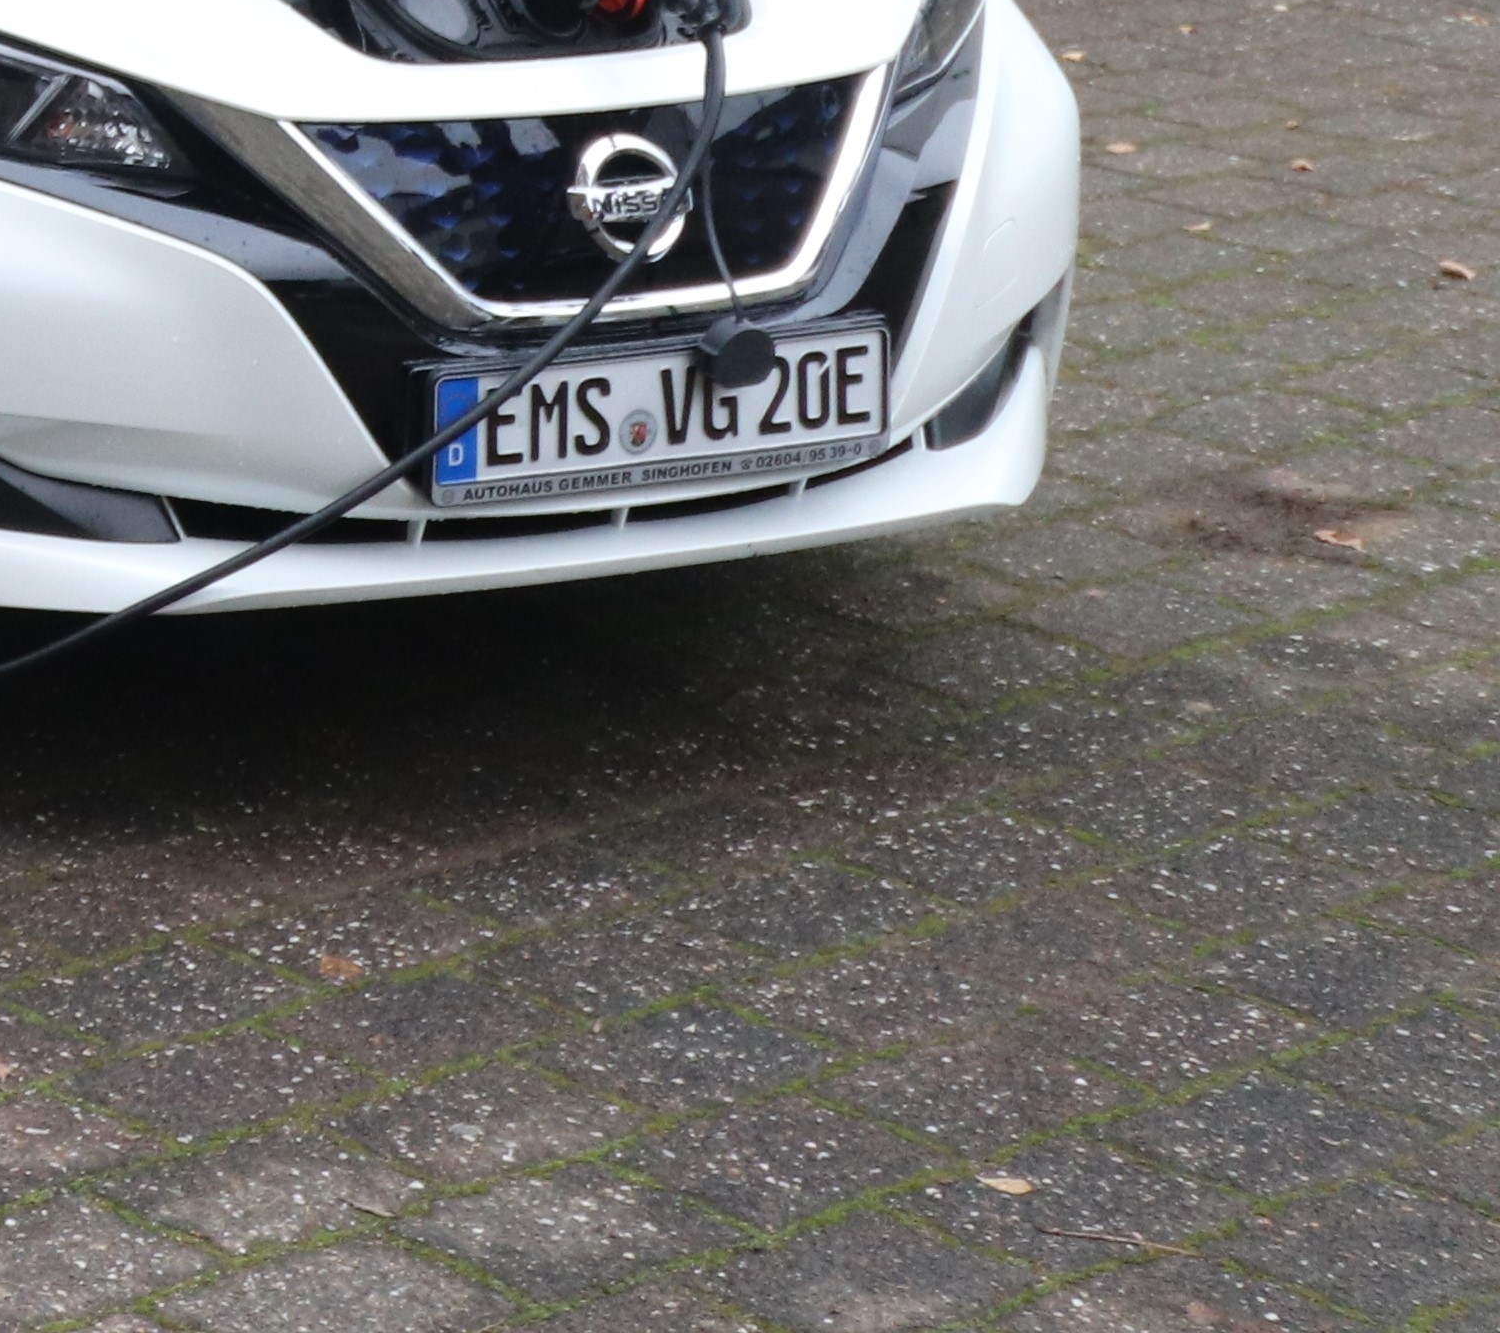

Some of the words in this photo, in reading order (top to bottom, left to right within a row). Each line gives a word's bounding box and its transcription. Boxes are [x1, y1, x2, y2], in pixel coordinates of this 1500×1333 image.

[591, 188, 684, 216] NISS
[485, 376, 612, 467] EMS
[660, 362, 739, 446] VG
[758, 344, 871, 436] 20E
[447, 443, 464, 467] D
[462, 478, 553, 502] AUTOHAUS
[558, 470, 632, 492] GEMMER
[641, 460, 733, 483] SINGHOFEN
